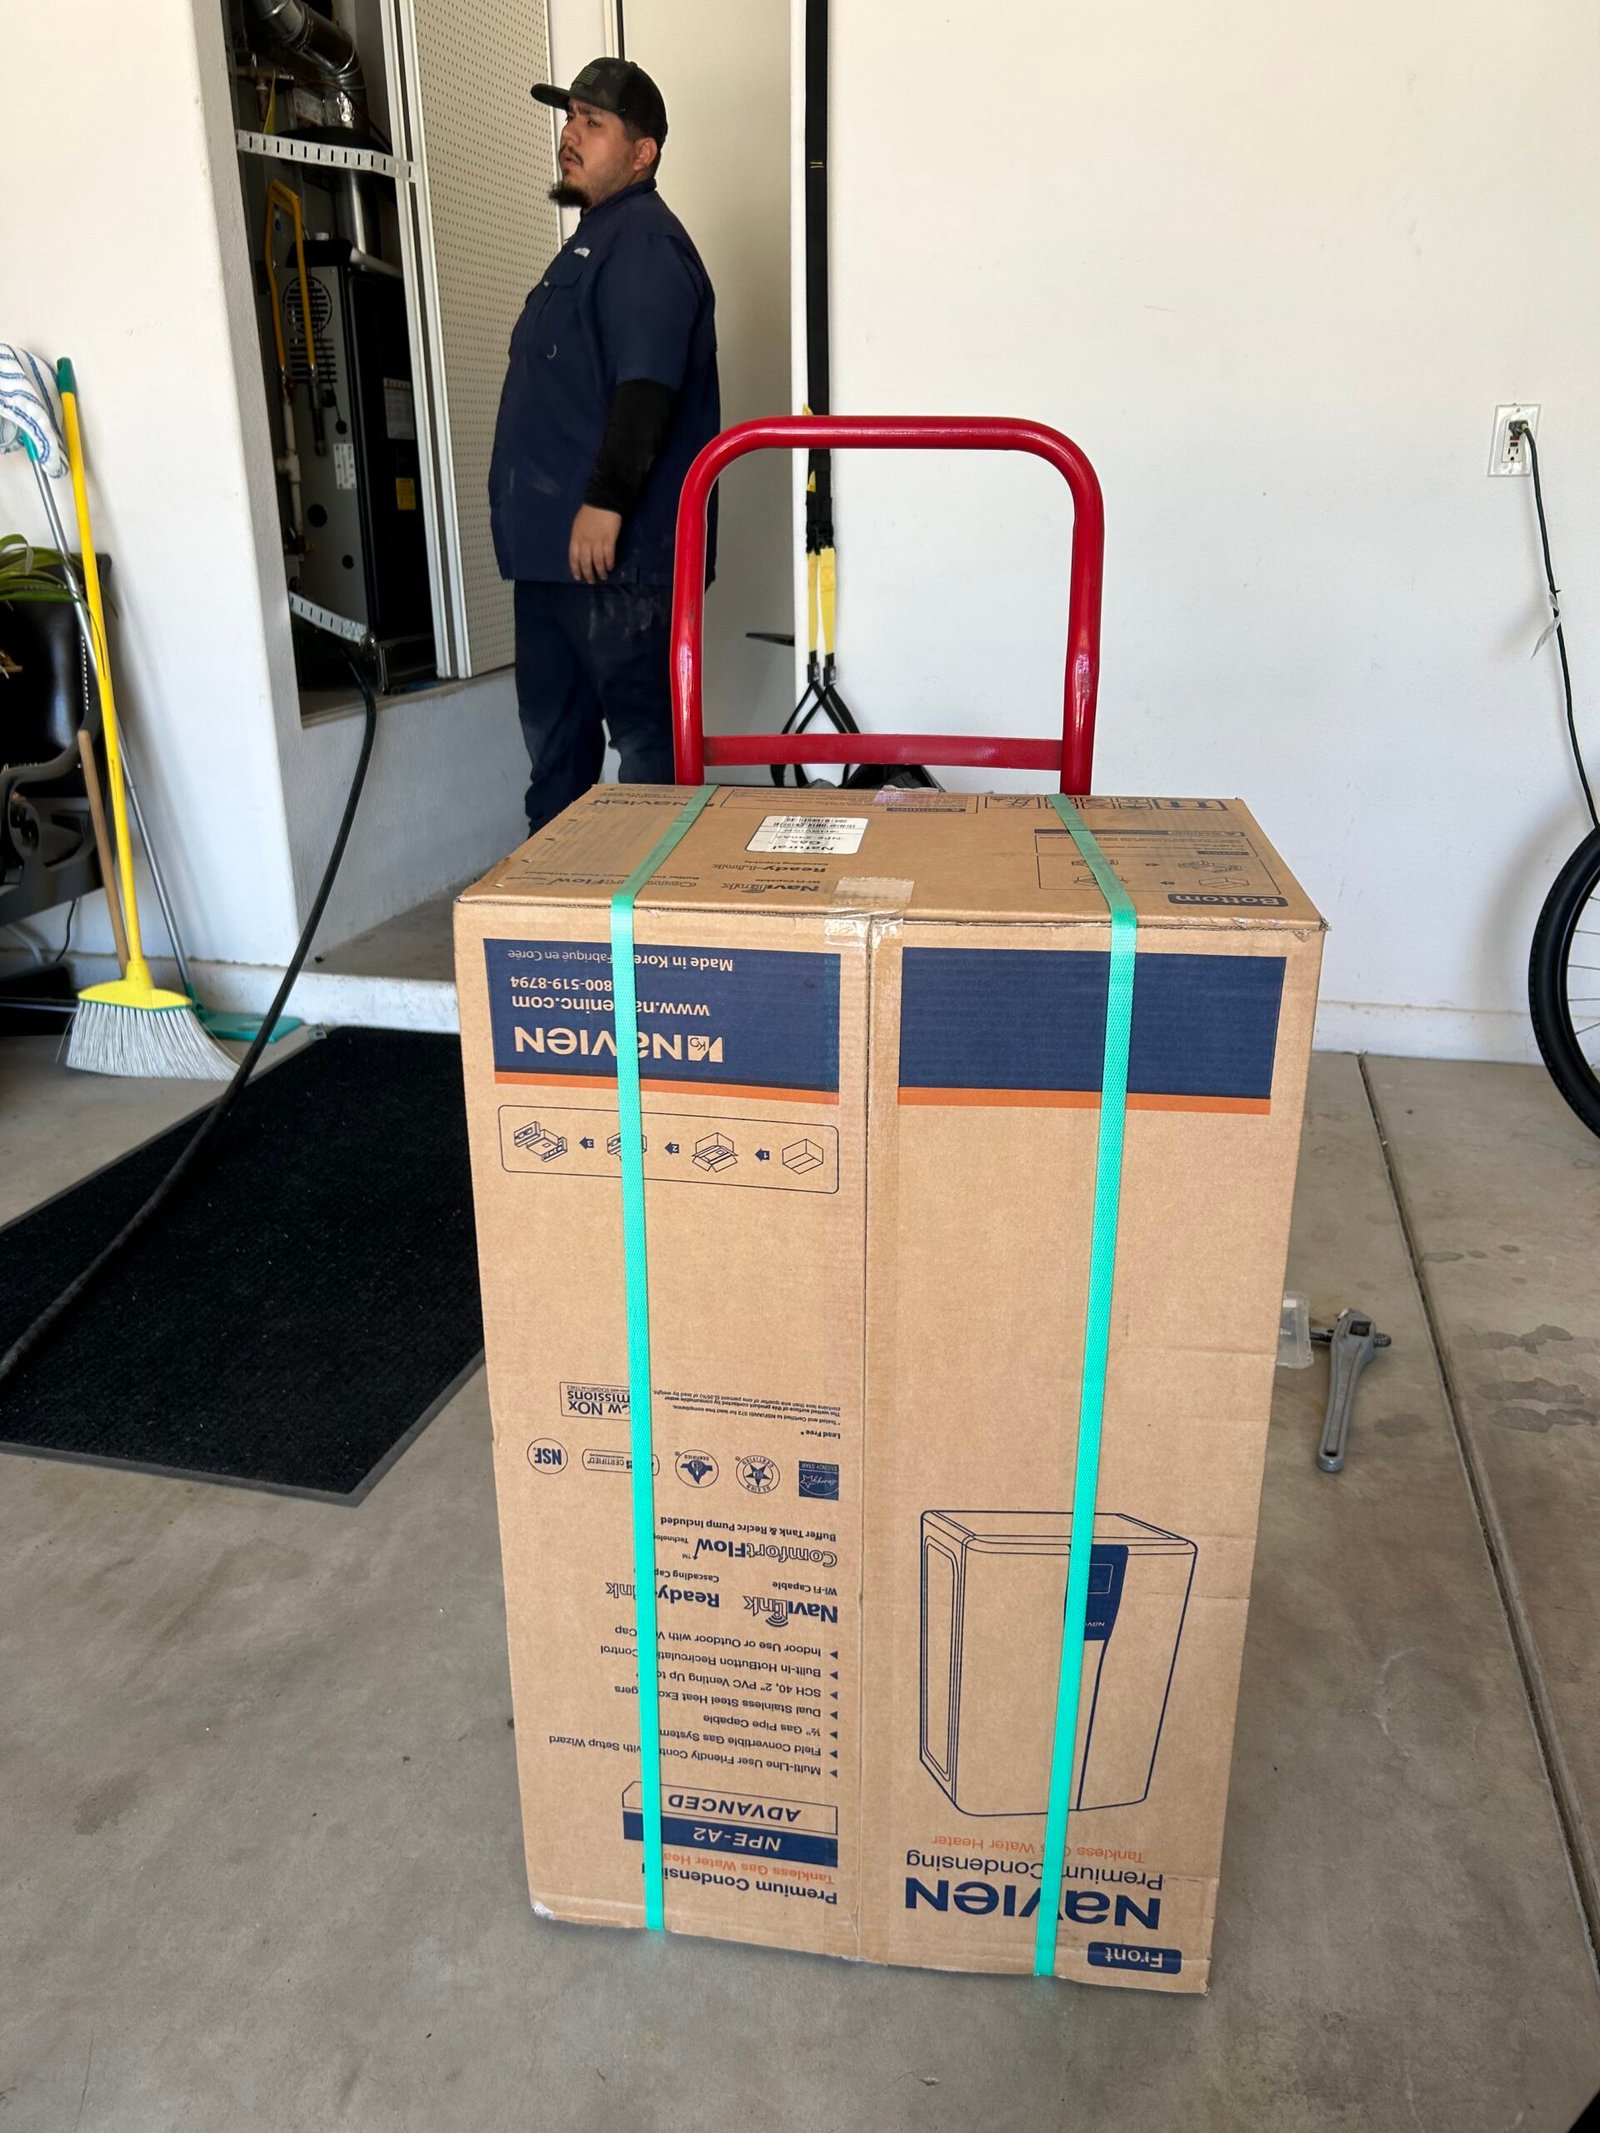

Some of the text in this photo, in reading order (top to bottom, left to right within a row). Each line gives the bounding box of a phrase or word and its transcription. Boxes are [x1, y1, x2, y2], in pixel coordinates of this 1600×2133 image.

[1175, 895, 1278, 905] Bottom
[507, 949, 542, 962] Corée
[544, 950, 559, 960] en
[634, 954, 733, 972] Made in Kore
[512, 995, 710, 1017] www.naeninc.com
[567, 1391, 630, 1403] missions
[568, 1401, 603, 1416] NOx
[534, 1447, 562, 1465] NSF
[660, 1516, 836, 1542] Buffer Tank & Recirc Pump Included
[653, 1534, 688, 1544] Technolo
[673, 1569, 720, 1582] Cascading
[605, 1582, 720, 1608] Ready-ink
[772, 1581, 837, 1596] Wi-Fi Capable
[743, 1595, 838, 1627] NaviLink
[615, 1626, 637, 1637] Cap
[668, 1632, 691, 1643] with
[694, 1635, 741, 1648] Outdoor
[744, 1640, 756, 1648] or
[759, 1641, 781, 1652] Use
[784, 1645, 821, 1656] Indoor
[655, 1651, 716, 1666] Recirculati
[719, 1658, 777, 1673] HotButton
[670, 1670, 685, 1681] Up
[781, 1664, 821, 1677] Built-In
[689, 1673, 729, 1687] Venting
[733, 1679, 756, 1690] PVC
[776, 1683, 792, 1694] 40,
[796, 1686, 821, 1697] SCH
[614, 1686, 821, 1718] Dual Stainless Steel Heat Excgers
[703, 1715, 749, 1728] Capable
[752, 1719, 776, 1731] Pipe
[780, 1724, 802, 1734] Gas
[549, 1736, 585, 1748] Wizard
[588, 1738, 620, 1751] Setup
[659, 1729, 821, 1756] Field Convertible Gas System
[691, 1750, 734, 1764] Friendly
[737, 1757, 763, 1767] User
[766, 1760, 821, 1775] Multi-Line
[668, 1794, 801, 1822] ADVANCED
[693, 1827, 781, 1851] NPE-A2
[931, 1835, 984, 1849] Heater
[988, 1839, 1034, 1854] Water
[1076, 1846, 1144, 1864] Tankless
[662, 1852, 834, 1885] Tankless Gas Water Hea
[905, 1849, 1163, 1891] Premium Condensing
[642, 1863, 837, 1905] Premium Condensi
[1104, 1946, 1164, 1968] Front
